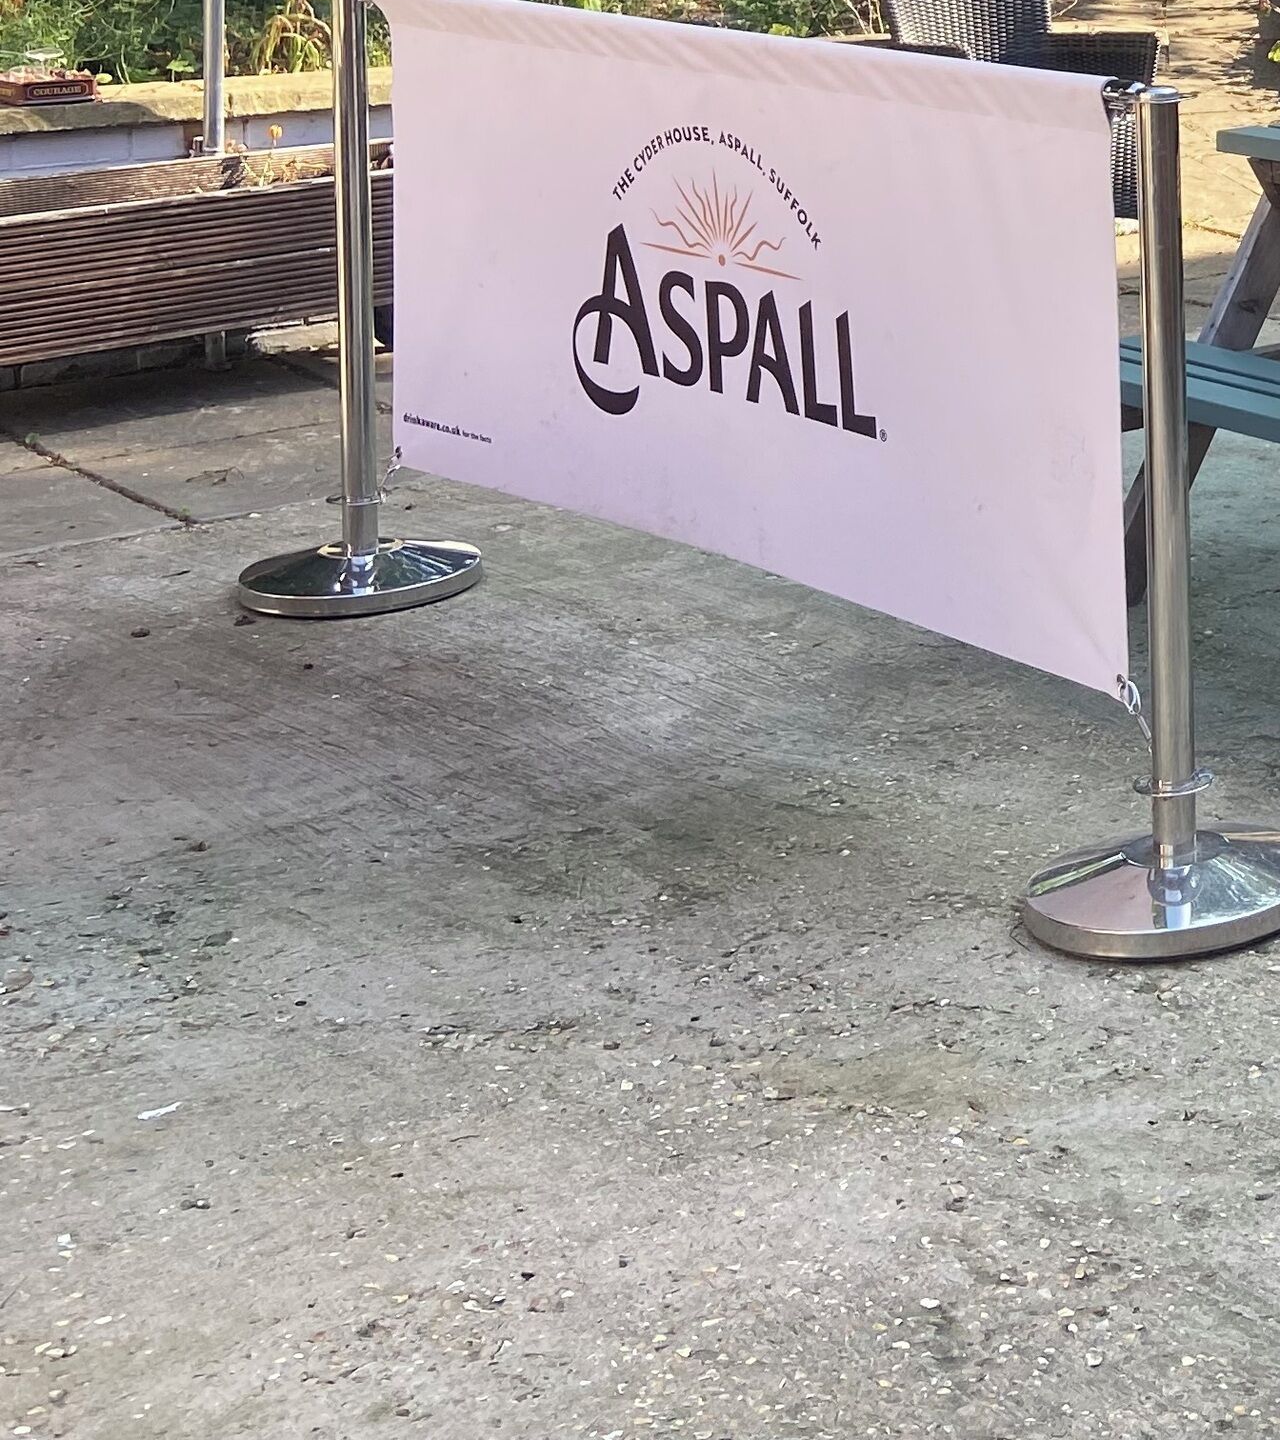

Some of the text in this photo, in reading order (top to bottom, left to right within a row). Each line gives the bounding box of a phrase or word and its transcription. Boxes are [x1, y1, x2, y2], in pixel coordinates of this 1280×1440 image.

[33, 86, 81, 96] COURAGE
[612, 168, 636, 201] THE
[633, 135, 666, 172] CYDER
[768, 168, 823, 252] SUFFOLK
[572, 222, 877, 440] ASPALL
[403, 411, 461, 436] drinkaware.co.uk
